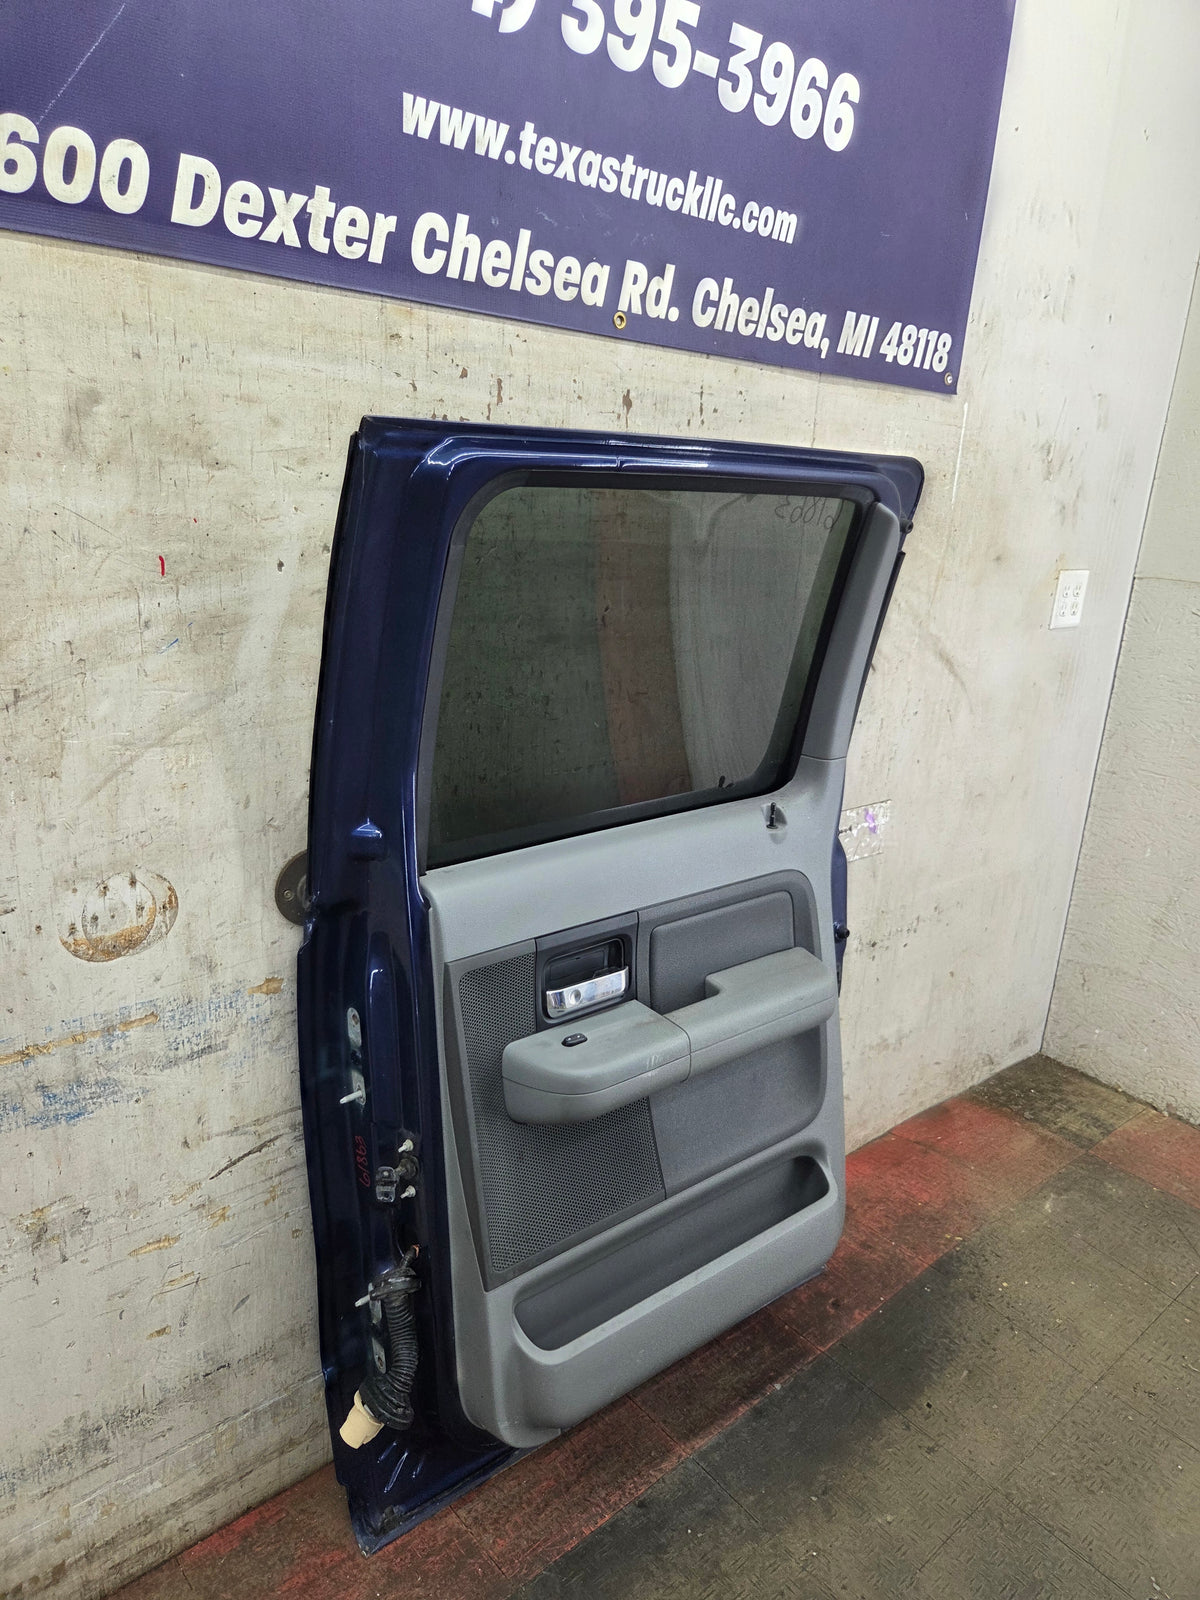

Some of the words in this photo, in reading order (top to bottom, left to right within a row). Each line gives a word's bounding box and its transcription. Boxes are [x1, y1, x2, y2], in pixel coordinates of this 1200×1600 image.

[0, 112, 150, 215] 600
[170, 152, 398, 265] Dexter
[410, 211, 611, 308] Chelsea
[617, 259, 680, 322] Rd.
[691, 277, 830, 359] Chelsea,
[836, 310, 880, 359] MI
[879, 321, 953, 373] 48118
[402, 92, 798, 245] www.texastruckllc.com
